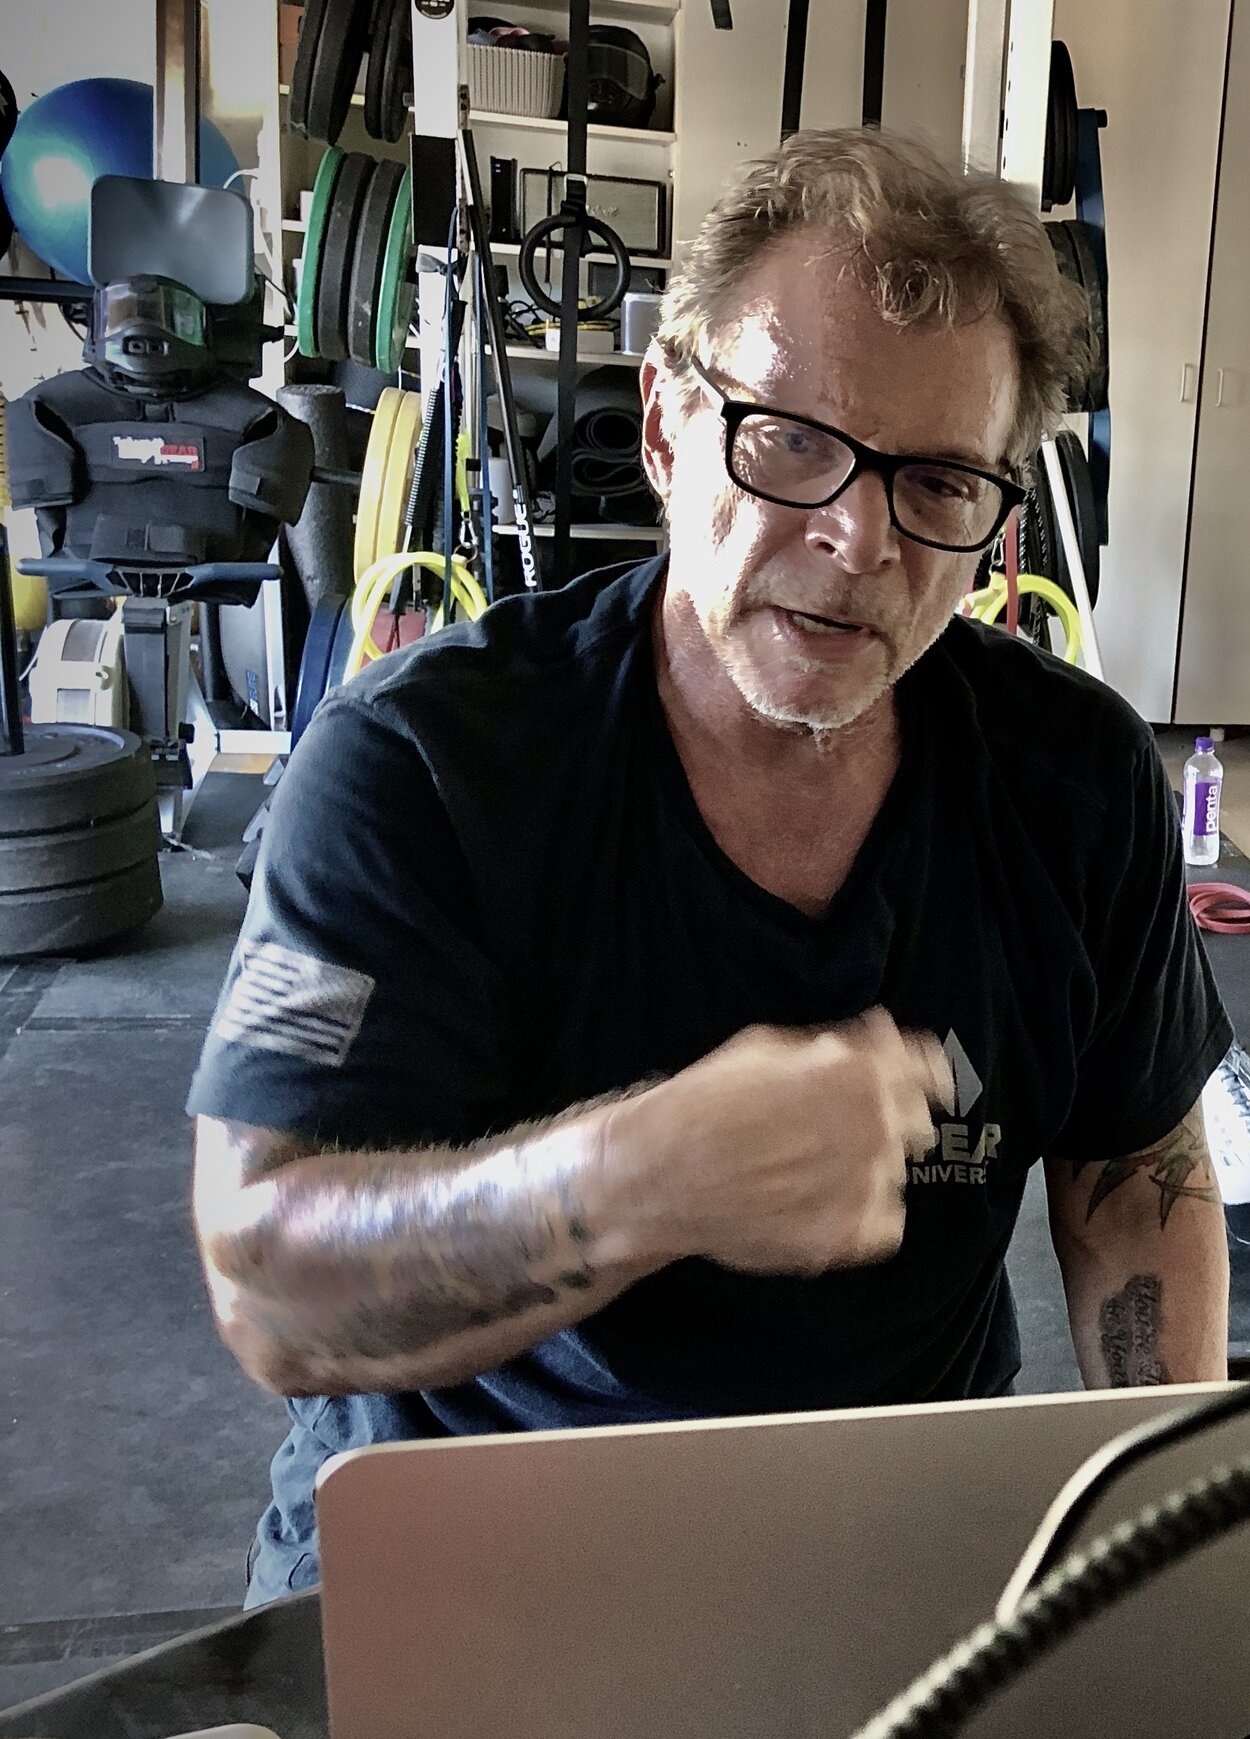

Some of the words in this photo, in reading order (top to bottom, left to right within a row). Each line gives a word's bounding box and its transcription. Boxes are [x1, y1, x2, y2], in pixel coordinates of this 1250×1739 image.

[514, 504, 537, 587] ROGUE
[1206, 785, 1218, 832] penta
[906, 1163, 987, 1185] NIVER
